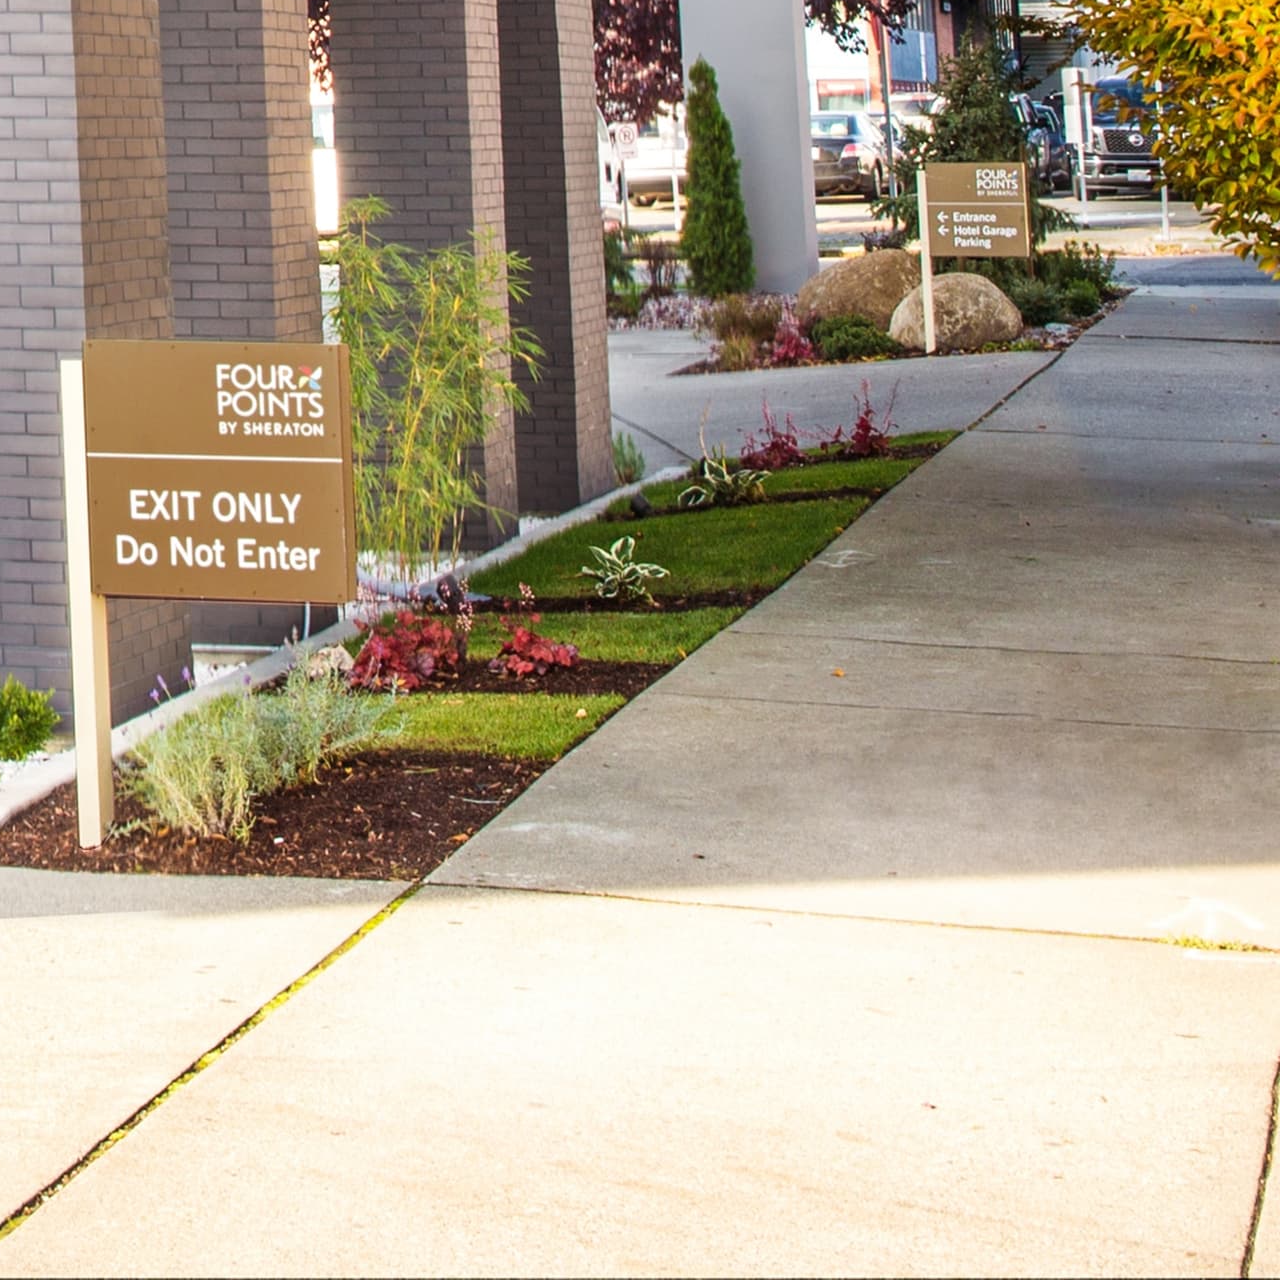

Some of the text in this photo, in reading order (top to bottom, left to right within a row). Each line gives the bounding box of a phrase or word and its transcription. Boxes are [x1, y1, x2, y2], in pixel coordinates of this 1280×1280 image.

[976, 169, 1007, 180] FOUR
[976, 180, 1018, 189] POINTS
[953, 212, 996, 222] Entrance
[954, 225, 1017, 237] Hotel Garage
[954, 237, 991, 249] Parking
[216, 364, 297, 390] FOUR
[217, 391, 324, 418] POINTS
[218, 421, 325, 437] BY SHERATON
[129, 489, 302, 524] EXIT ONLY
[116, 534, 321, 571] Do Not Enter
